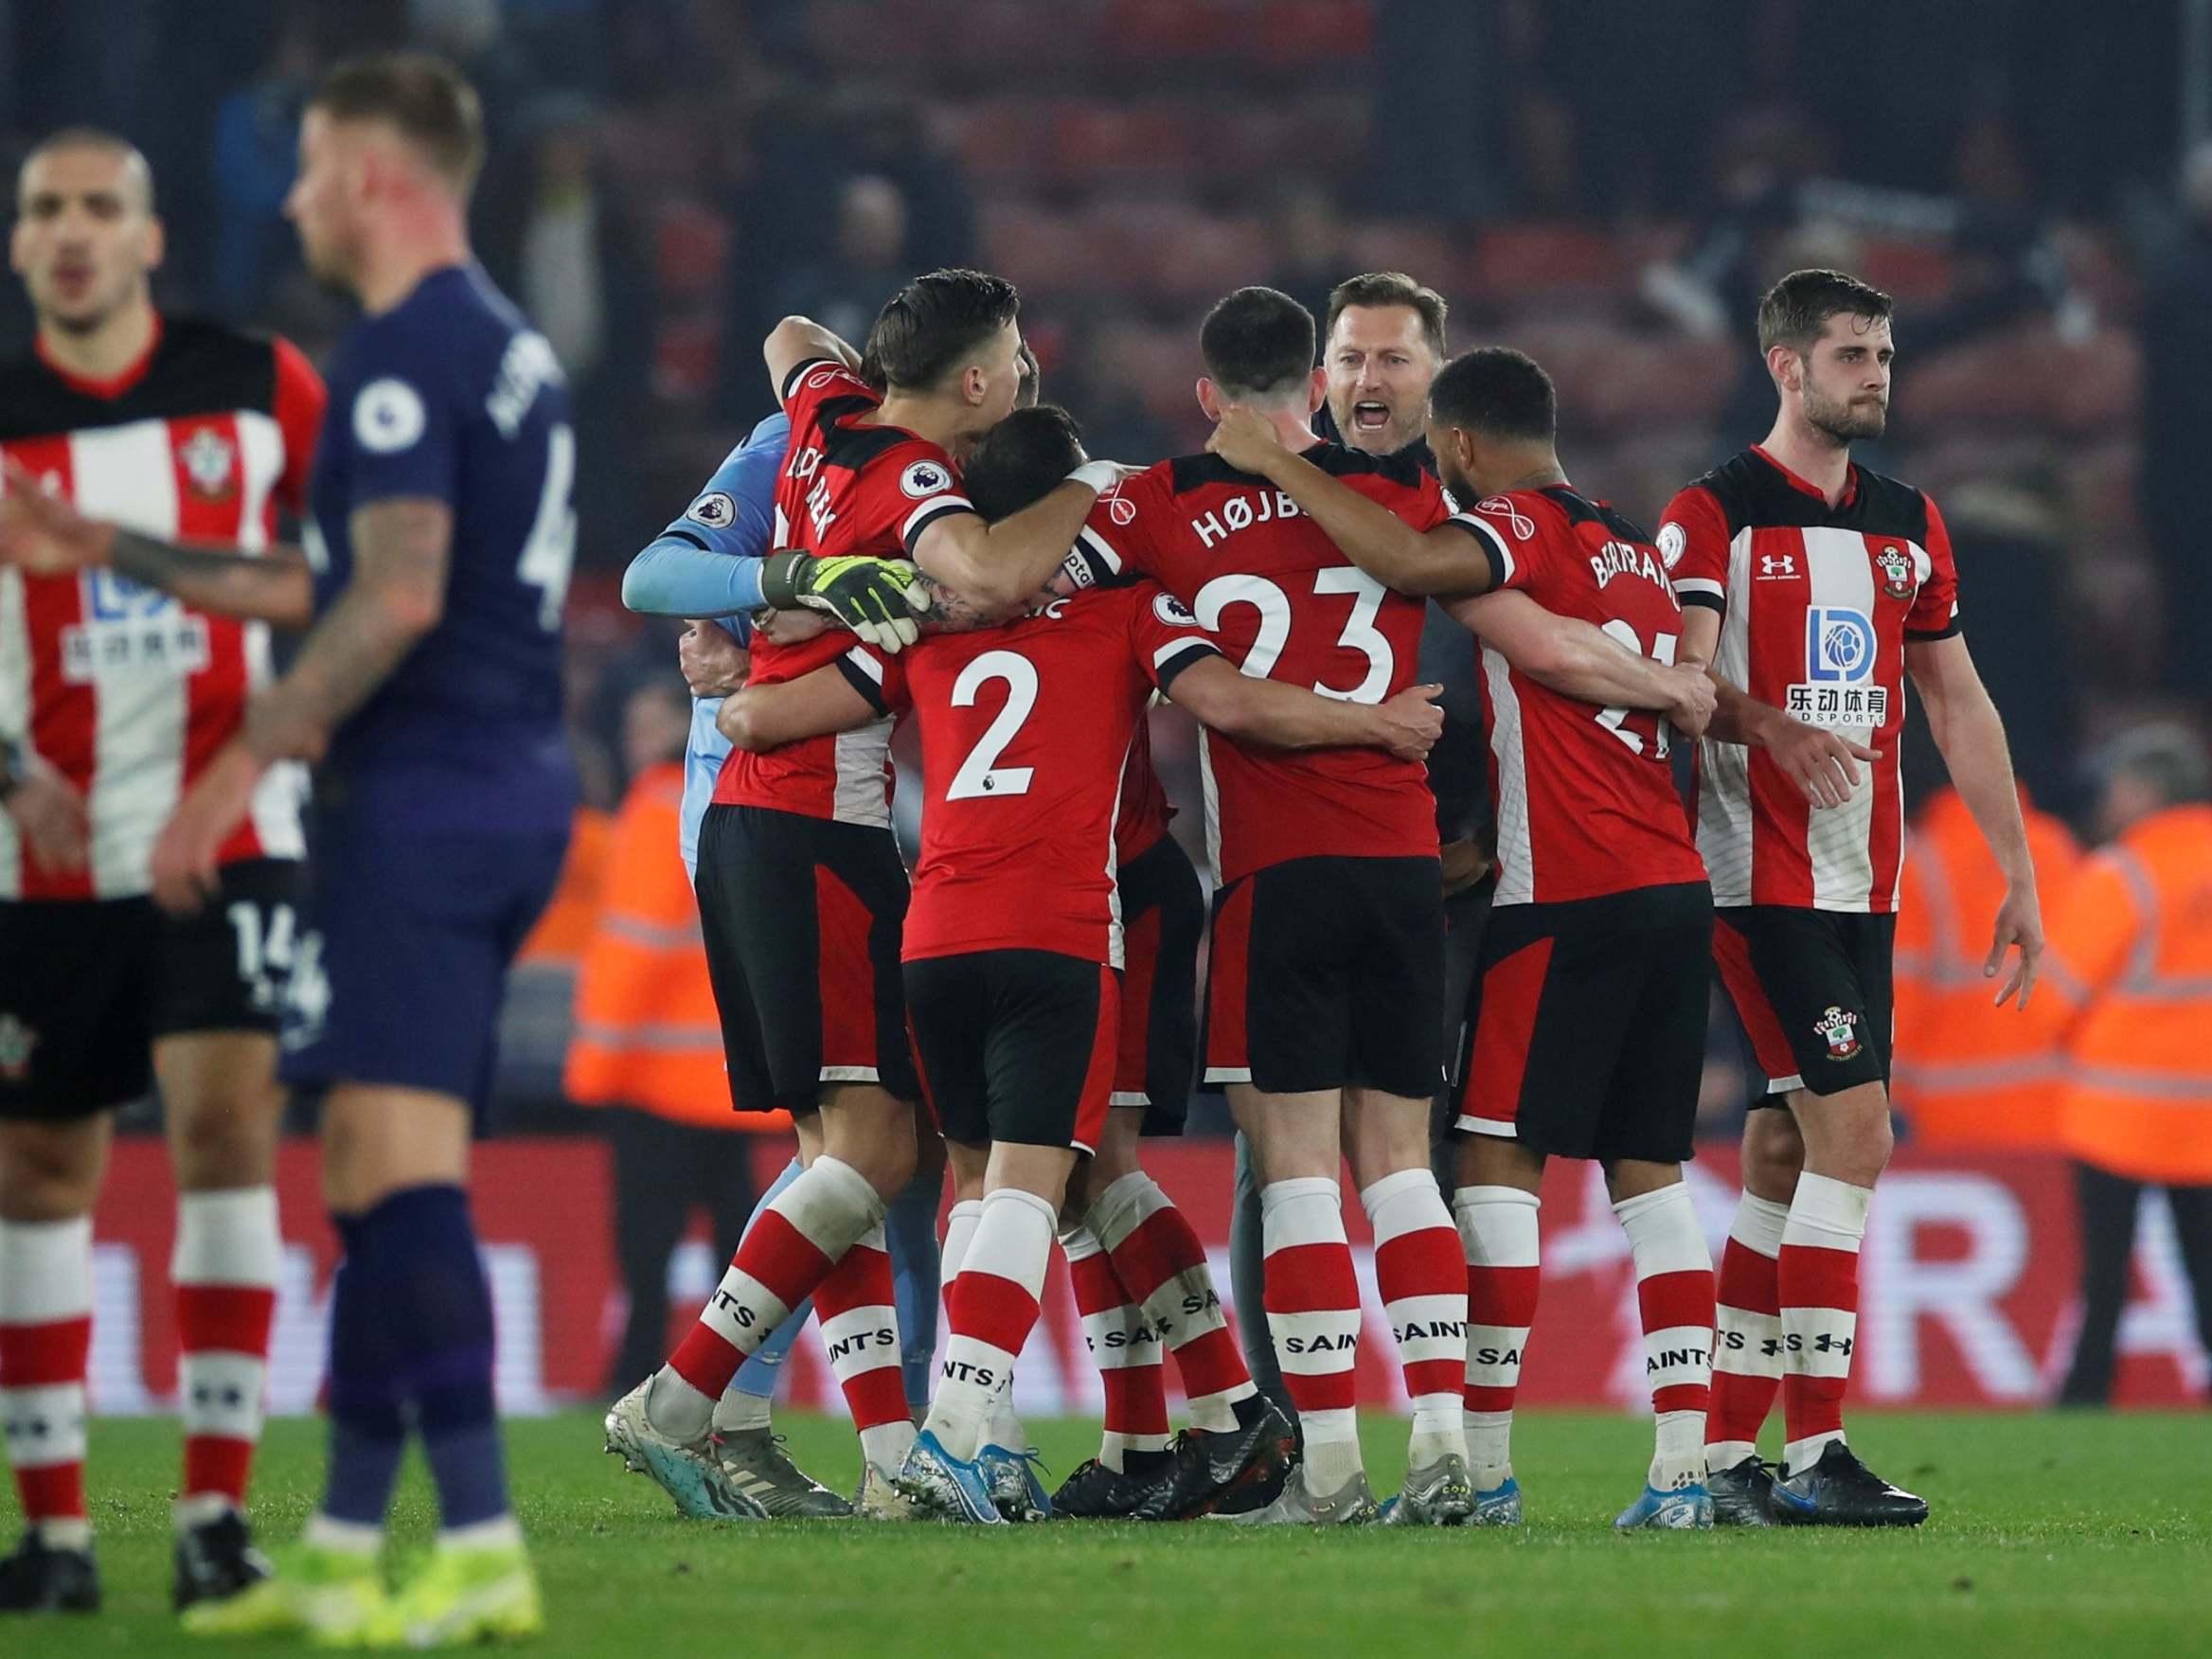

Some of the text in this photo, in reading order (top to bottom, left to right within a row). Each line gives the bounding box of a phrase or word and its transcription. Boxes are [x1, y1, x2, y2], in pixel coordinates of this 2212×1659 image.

[1191, 491, 1309, 548] HØJB
[1194, 566, 1394, 705] 23
[947, 650, 1039, 800] 2
[1789, 712, 1885, 723] DSPORTS
[1790, 687, 1886, 713] 乐动体育
